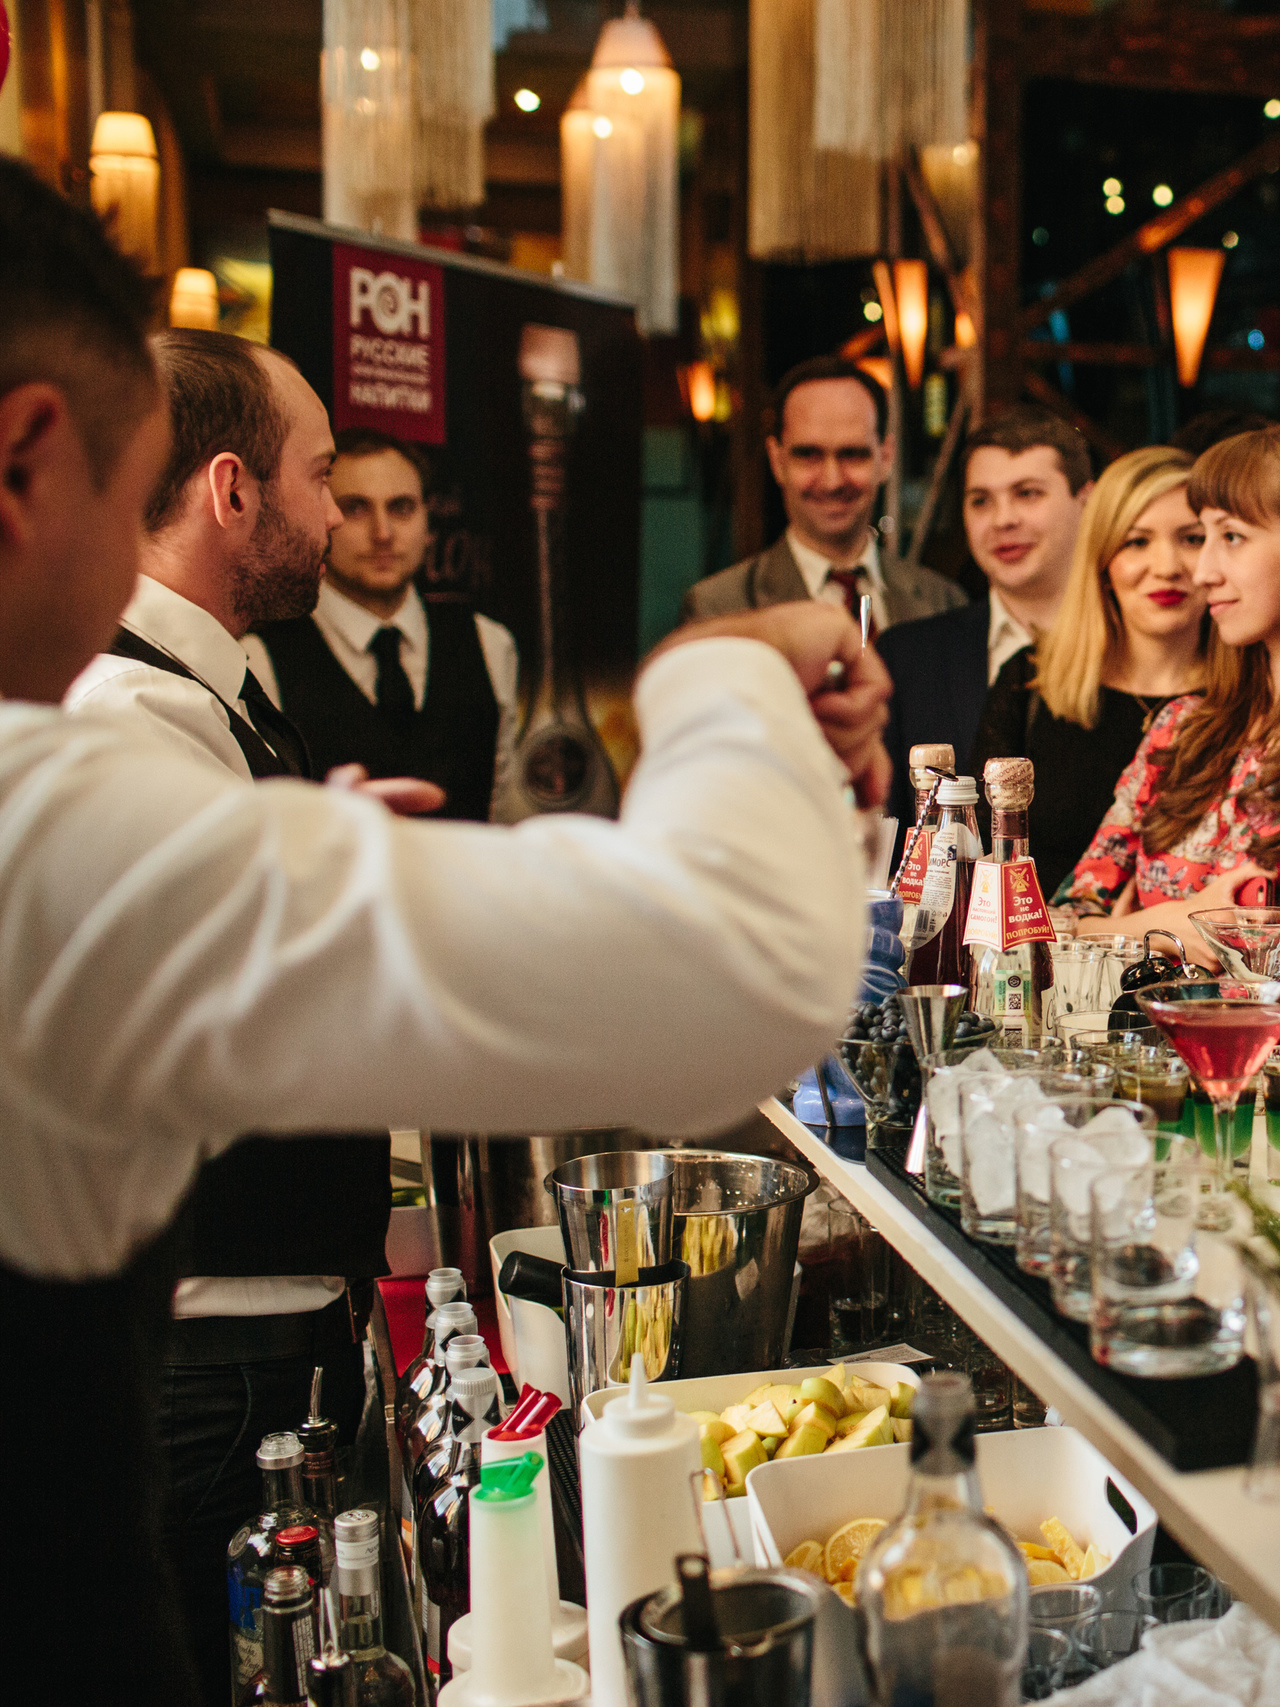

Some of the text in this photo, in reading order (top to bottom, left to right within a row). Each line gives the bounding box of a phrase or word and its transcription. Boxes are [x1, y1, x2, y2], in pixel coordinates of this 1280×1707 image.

[907, 860, 922, 871] Это
[977, 896, 991, 908] Это
[1013, 896, 1033, 906] Это
[1008, 908, 1043, 923] водка!
[1006, 924, 1050, 940] ПОПРОБУЙ!
